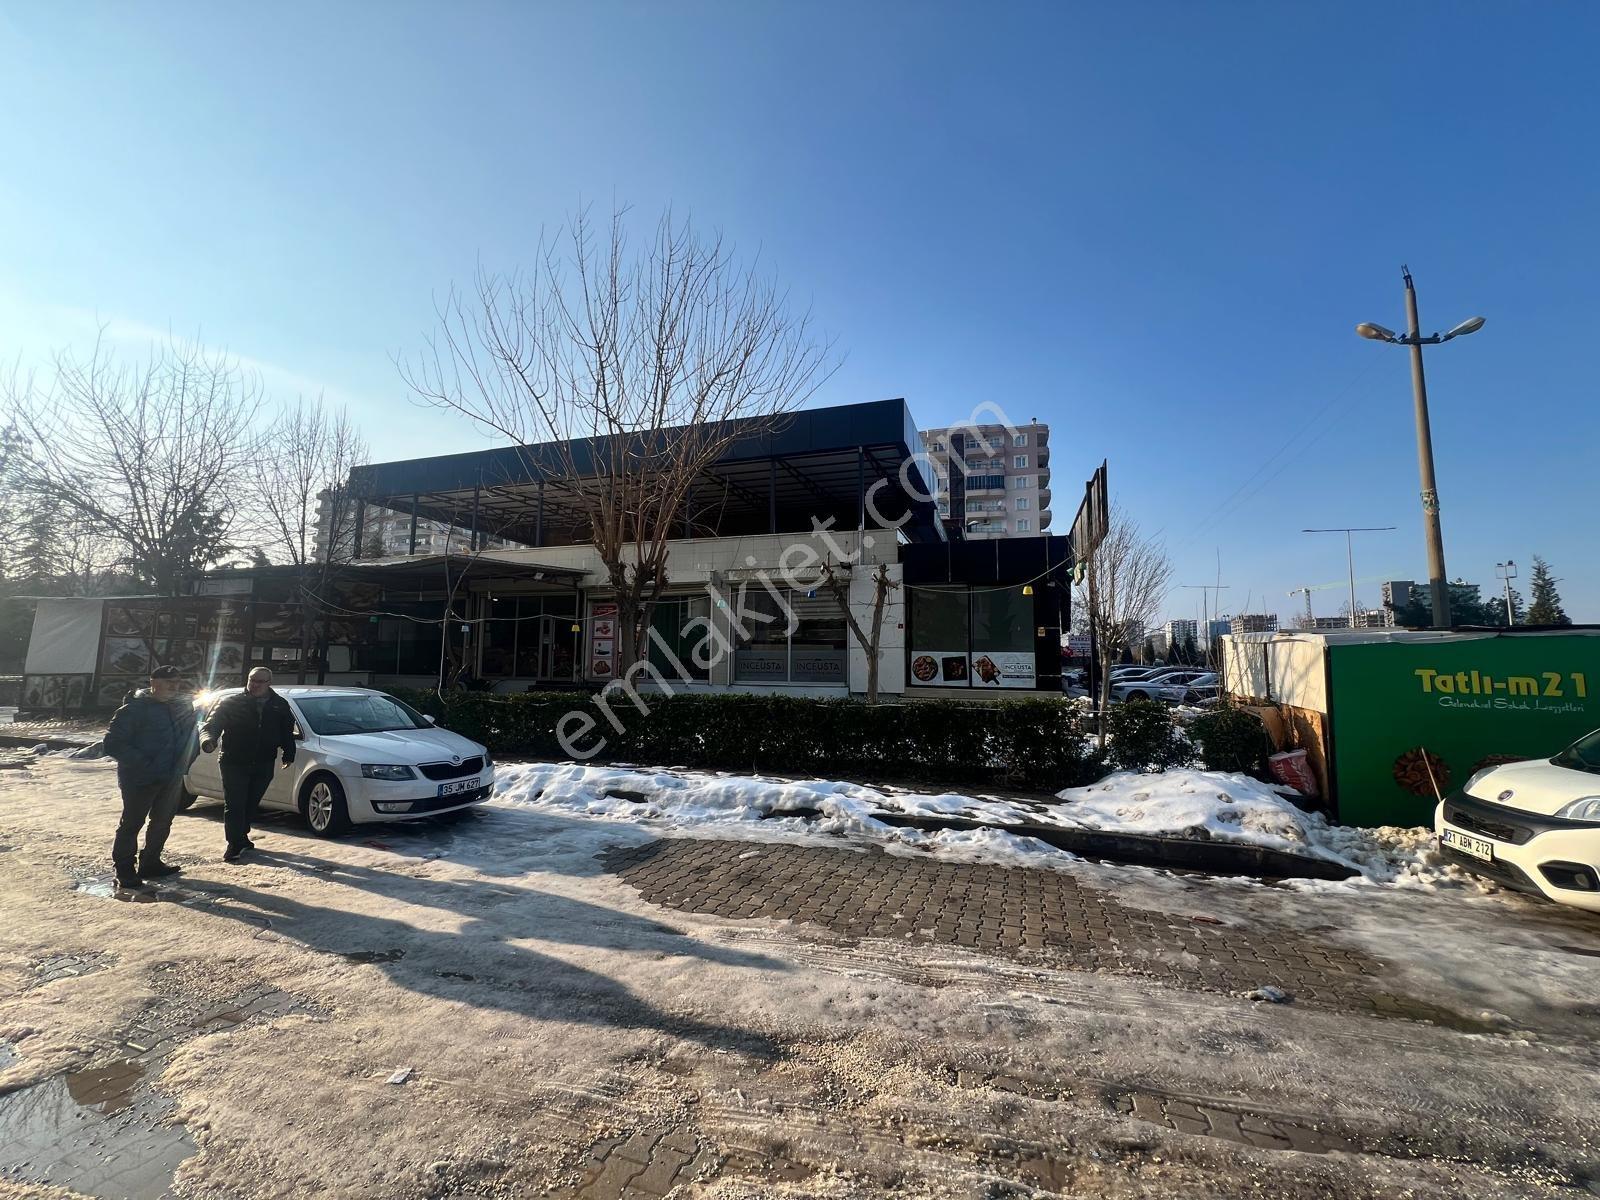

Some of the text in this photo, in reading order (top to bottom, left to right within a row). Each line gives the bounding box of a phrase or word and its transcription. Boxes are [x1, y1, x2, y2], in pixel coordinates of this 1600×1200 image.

[200, 625, 246, 635] MAGAL
[443, 784, 453, 794] 35
[466, 779, 479, 790] 627
[1448, 831, 1456, 843] 21
[1459, 836, 1472, 849] ABN
[1475, 841, 1490, 856] 212
